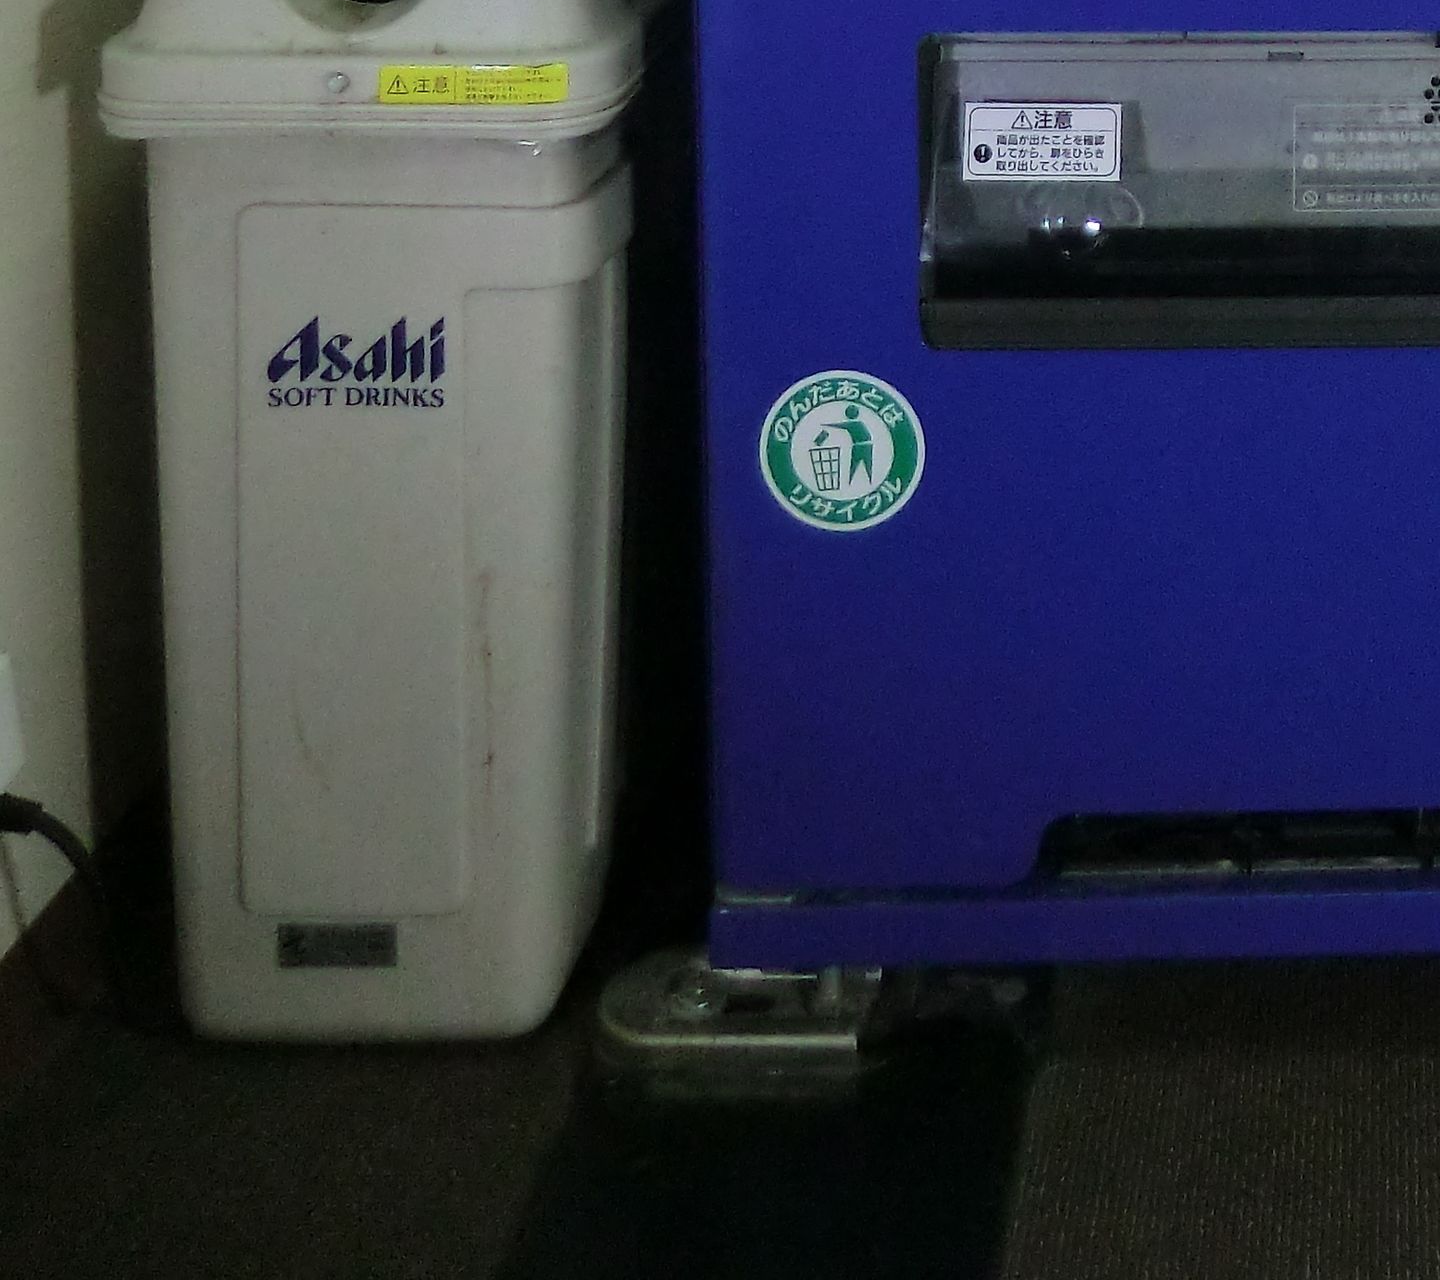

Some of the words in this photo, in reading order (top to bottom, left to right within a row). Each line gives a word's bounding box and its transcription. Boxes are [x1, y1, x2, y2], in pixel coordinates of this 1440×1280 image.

[1033, 109, 1074, 130] 注意
[996, 133, 1106, 147] 商品が出たことを確認
[995, 159, 1100, 173] 取り出してください。
[267, 314, 446, 384] Asahi
[267, 386, 338, 408] SOFT
[345, 387, 445, 409] DRINKS
[773, 379, 906, 443] のんだあとは
[788, 476, 903, 522] リサイクル
